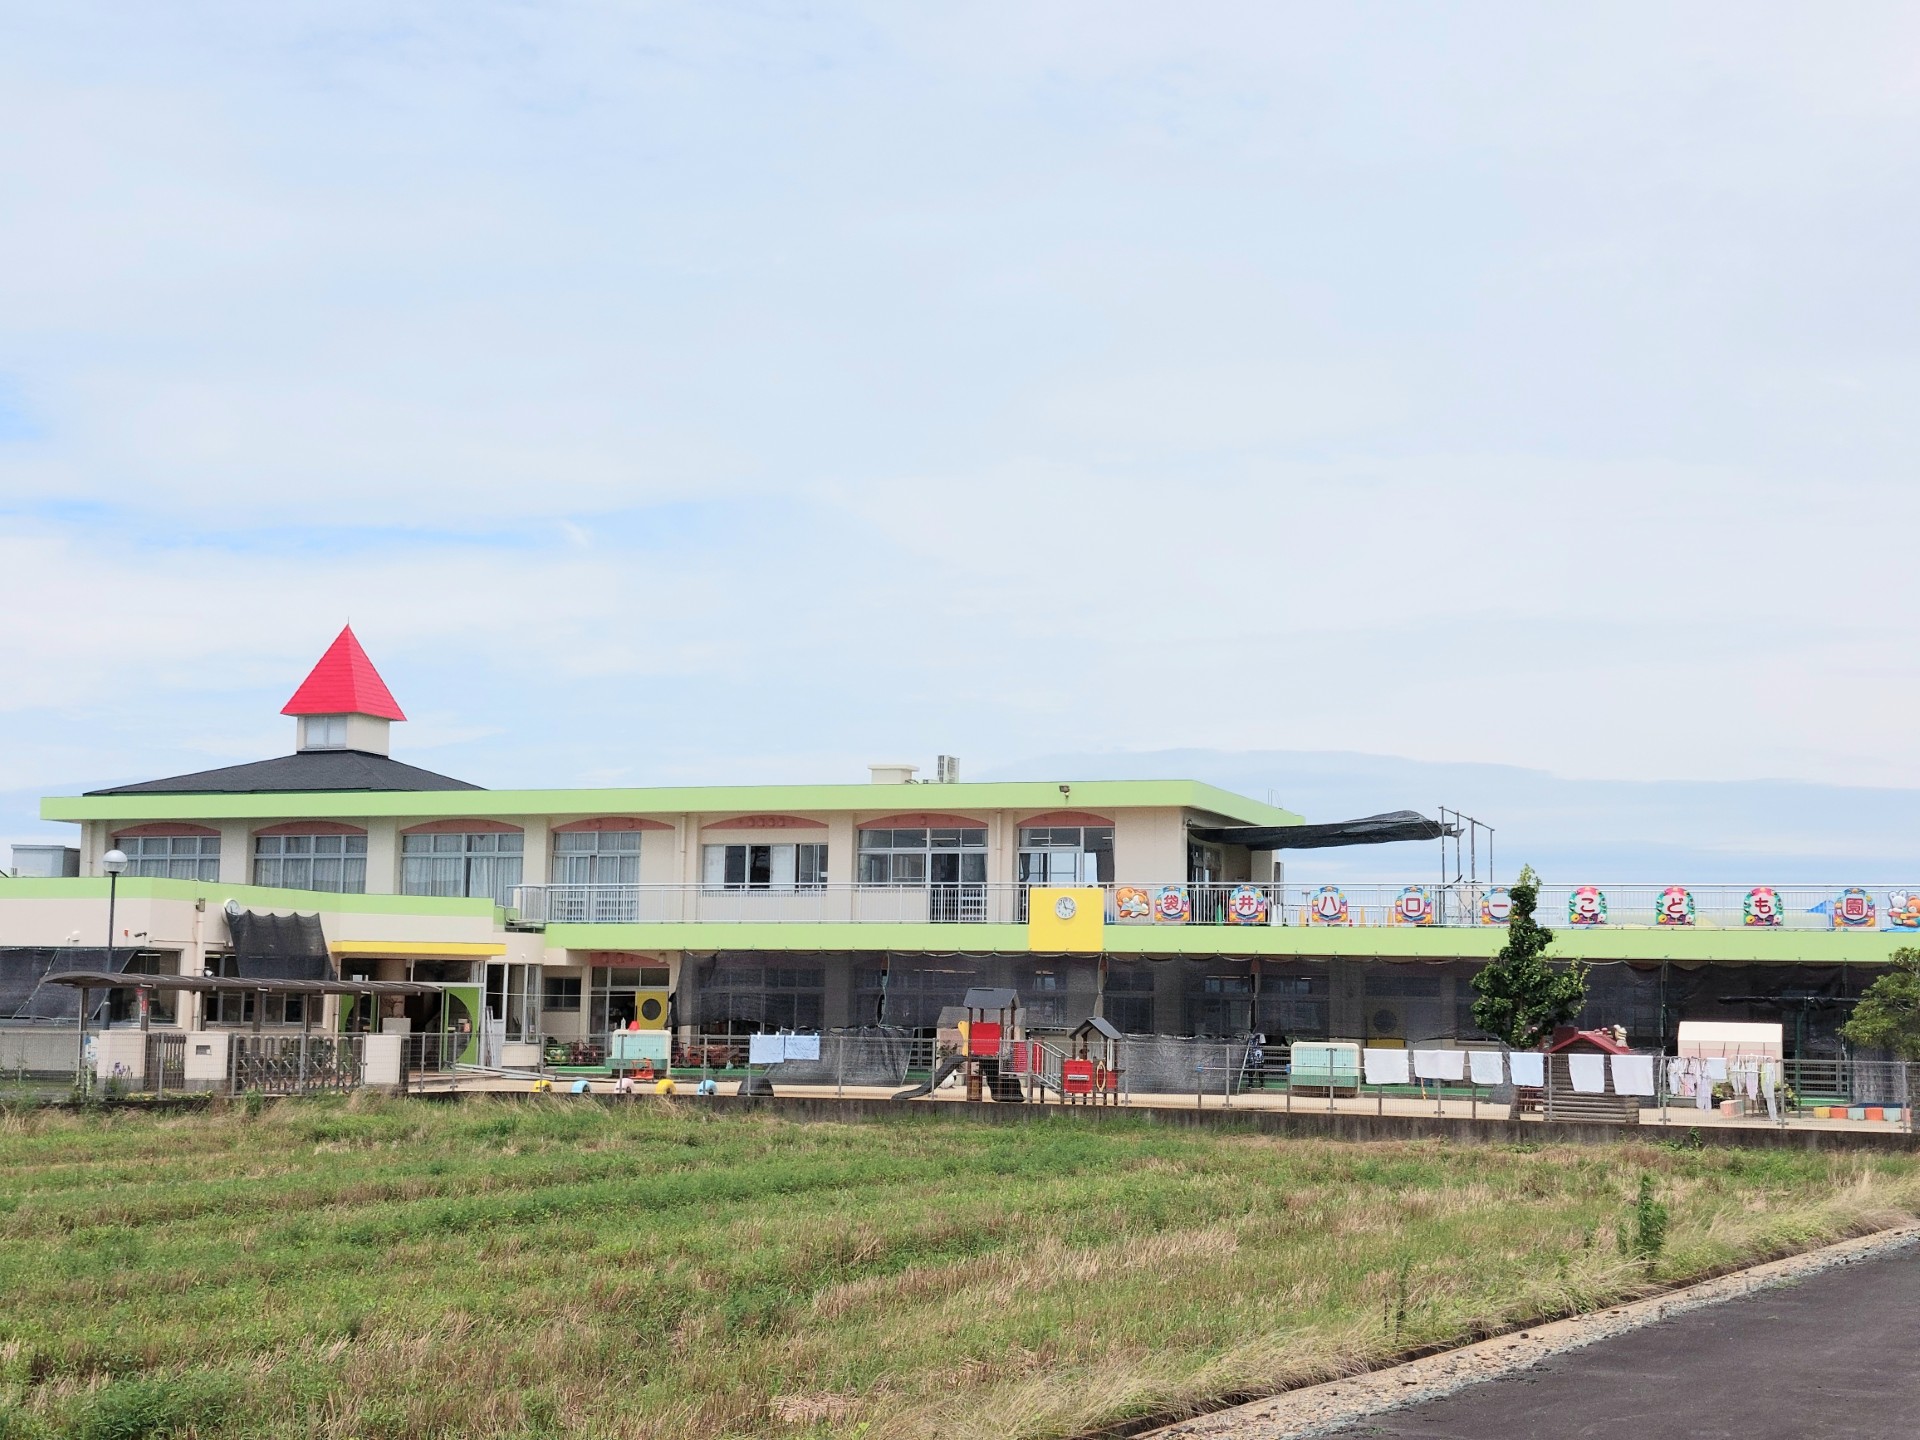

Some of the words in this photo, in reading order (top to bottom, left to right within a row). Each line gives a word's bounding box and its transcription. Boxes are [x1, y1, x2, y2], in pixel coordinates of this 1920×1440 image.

[1164, 895, 1179, 911] 袋
[1239, 895, 1254, 910] 井
[1580, 898, 1595, 912] こ
[1667, 897, 1684, 914] ど
[1754, 897, 1771, 914] も
[1846, 898, 1864, 915] 園
